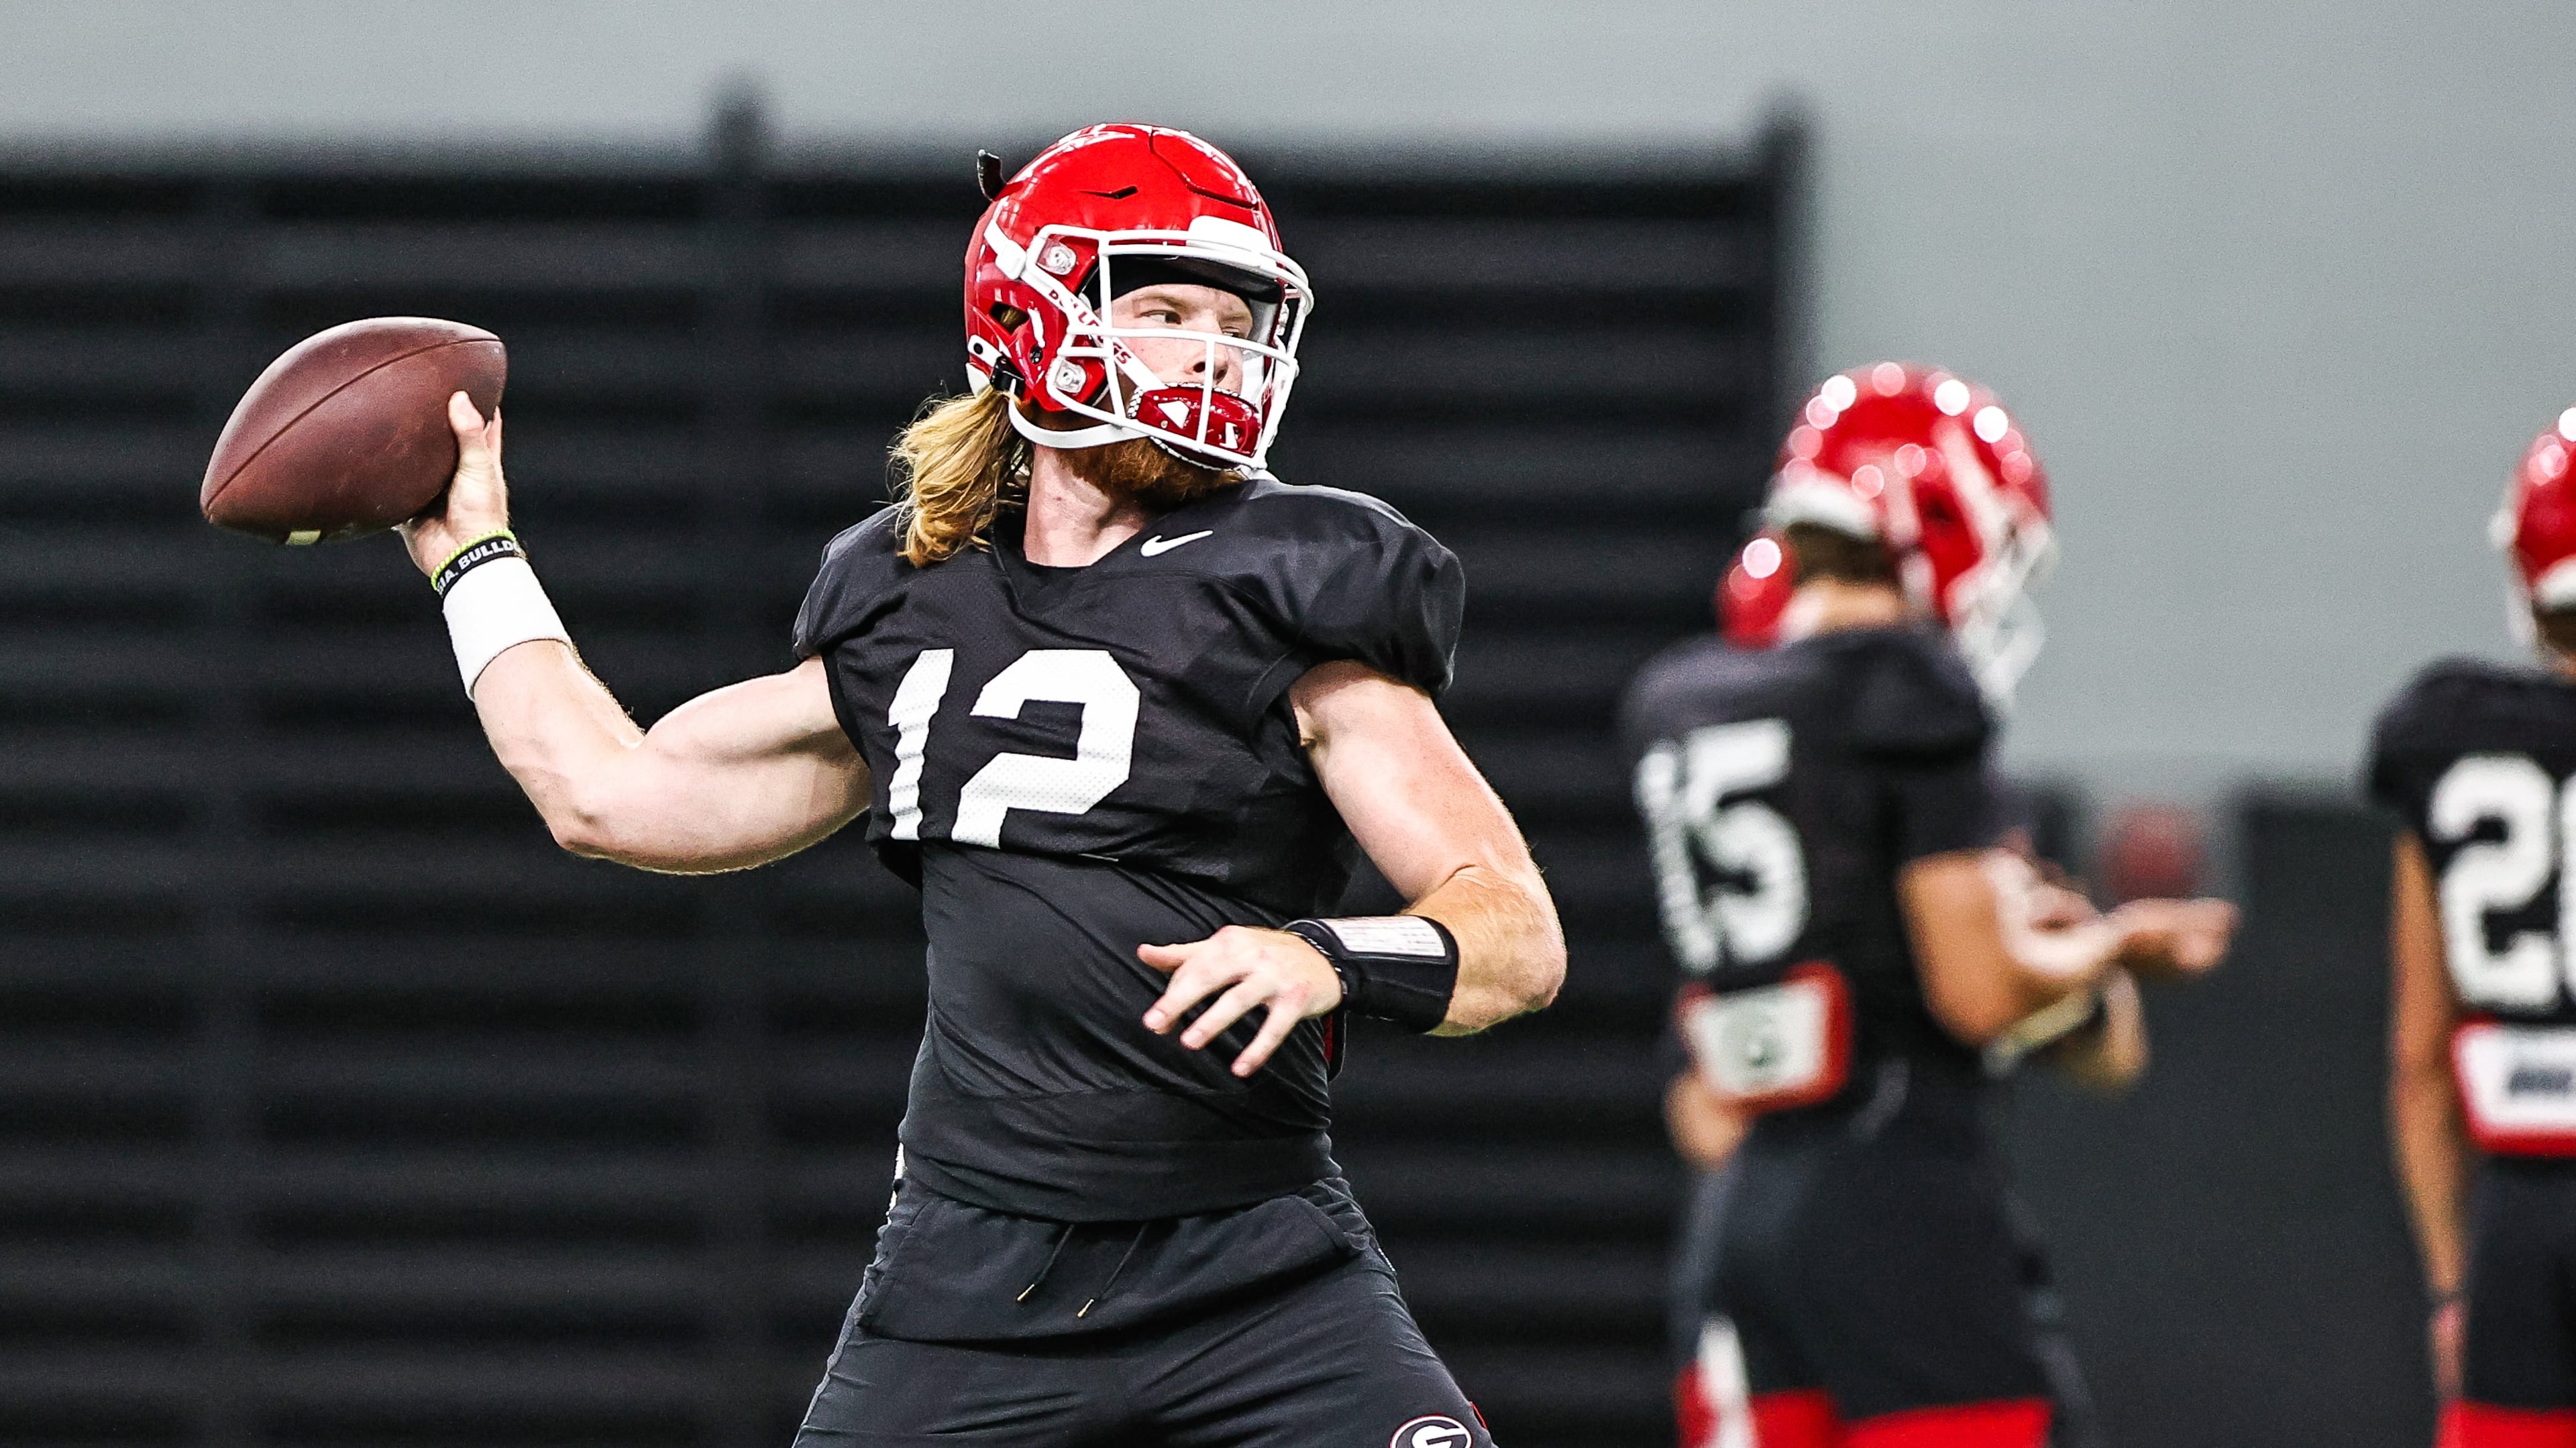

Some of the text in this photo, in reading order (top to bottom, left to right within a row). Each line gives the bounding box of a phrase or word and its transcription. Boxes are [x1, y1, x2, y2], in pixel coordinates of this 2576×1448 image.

[888, 649, 1140, 849] 12
[1633, 717, 1810, 972] 15
[2429, 753, 2576, 1009] 2
